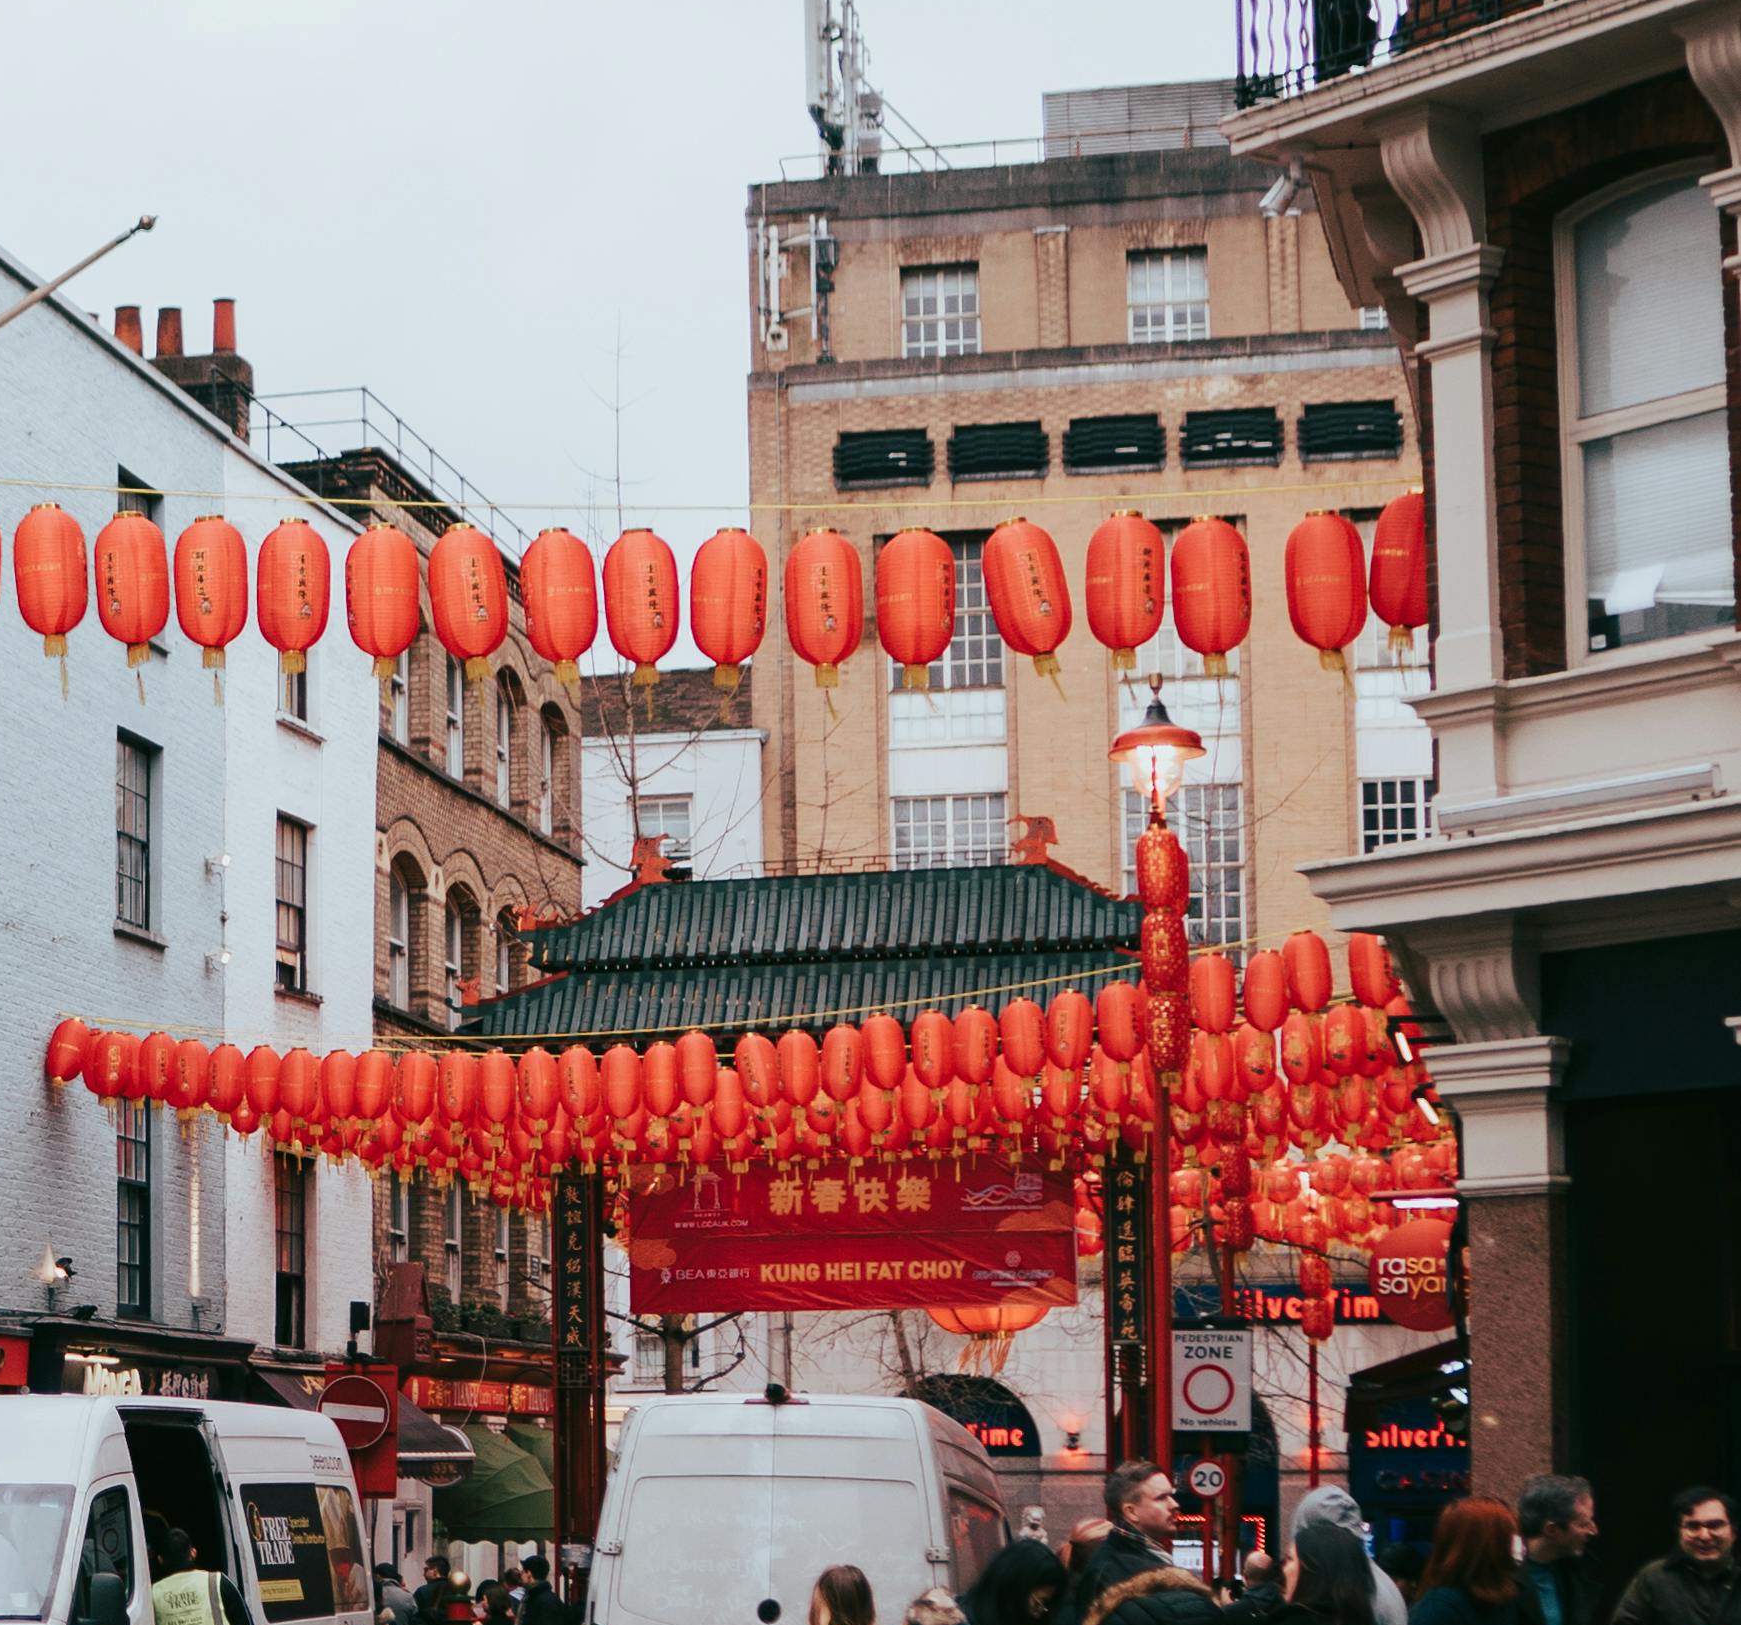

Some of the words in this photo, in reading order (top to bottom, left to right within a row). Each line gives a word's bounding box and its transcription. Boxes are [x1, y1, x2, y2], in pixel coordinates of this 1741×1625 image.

[769, 1176, 933, 1215] 新春快樂
[761, 1263, 821, 1283] KUNG
[825, 1262, 861, 1282] HEI
[865, 1261, 904, 1281] FAT
[908, 1259, 966, 1280] CHOY
[1378, 1257, 1436, 1275] rasa
[1175, 1334, 1244, 1343] PEDESTRIAN
[1184, 1346, 1234, 1359] ZONE
[1180, 1418, 1194, 1426] No
[1198, 1418, 1238, 1426] vehicles
[1194, 1471, 1223, 1487] 20
[260, 1516, 291, 1541] FREE
[257, 1541, 295, 1565] TRADE
